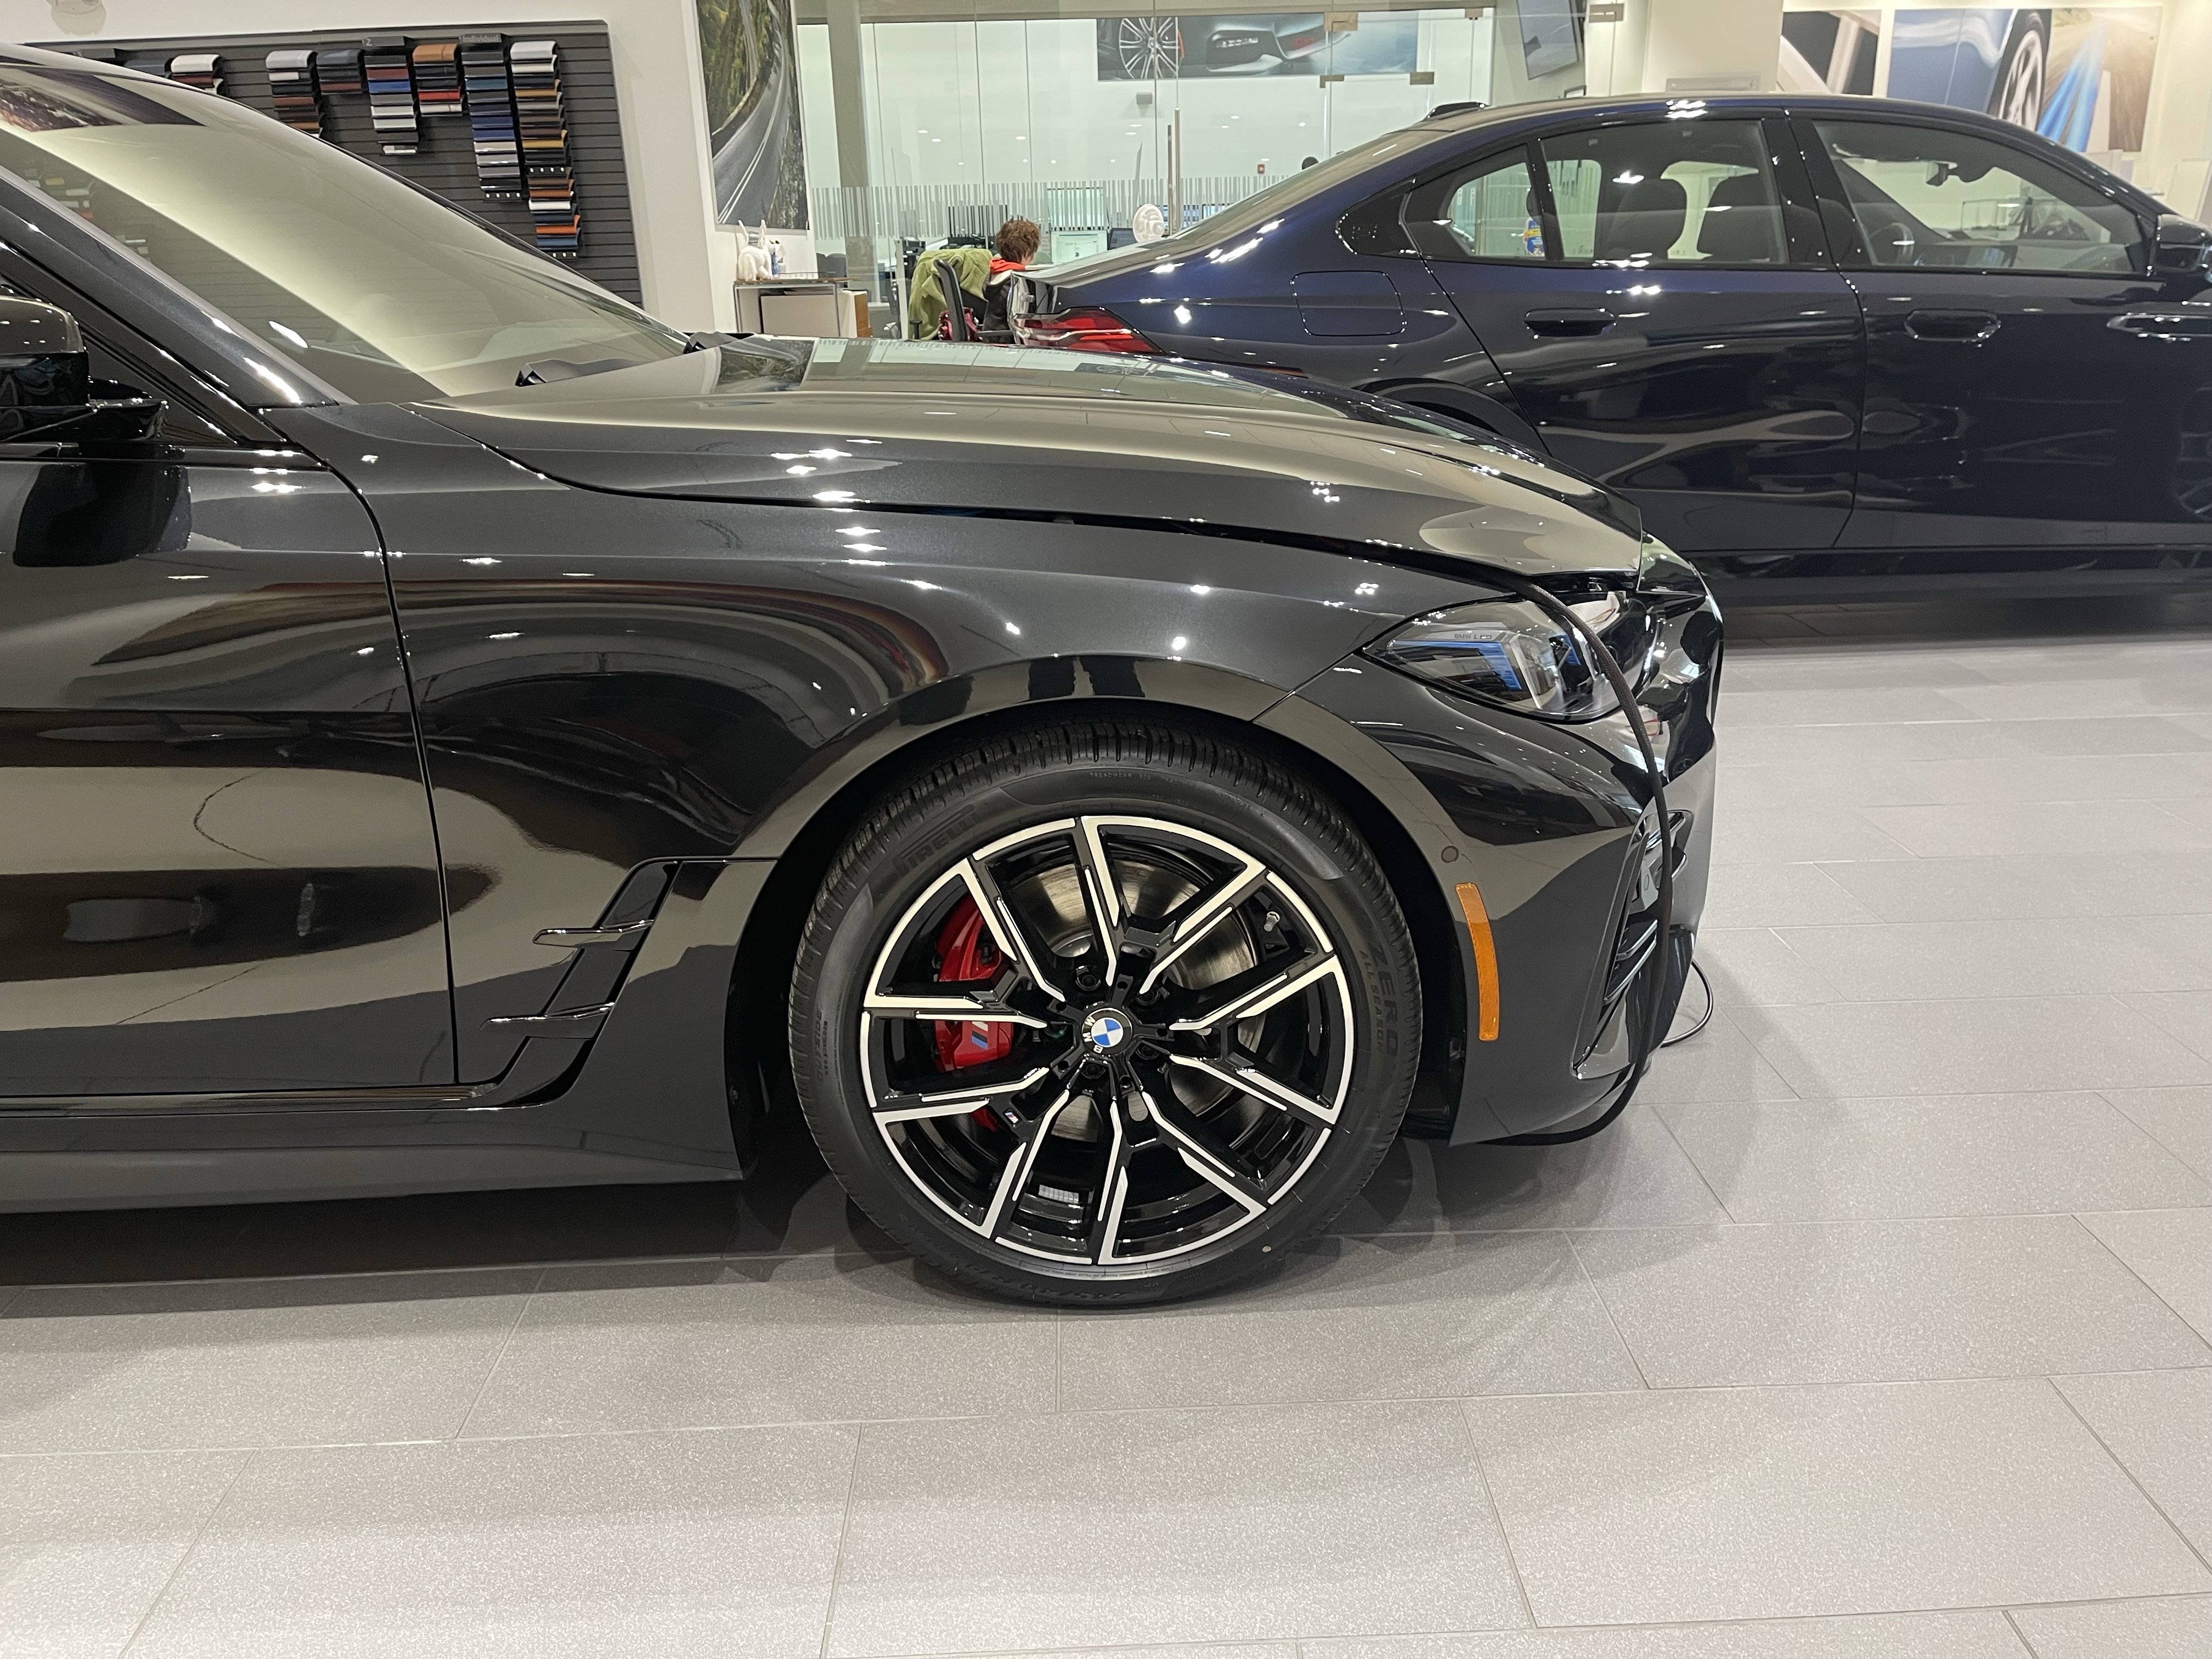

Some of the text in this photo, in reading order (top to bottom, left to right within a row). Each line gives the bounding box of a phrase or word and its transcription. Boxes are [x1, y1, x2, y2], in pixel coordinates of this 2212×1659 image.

[462, 35, 499, 43] Individual
[891, 804, 981, 878] PIRELLI
[1359, 950, 1375, 979] ALL
[1367, 941, 1398, 1057] ZERO
[1082, 1016, 1104, 1053] BMW
